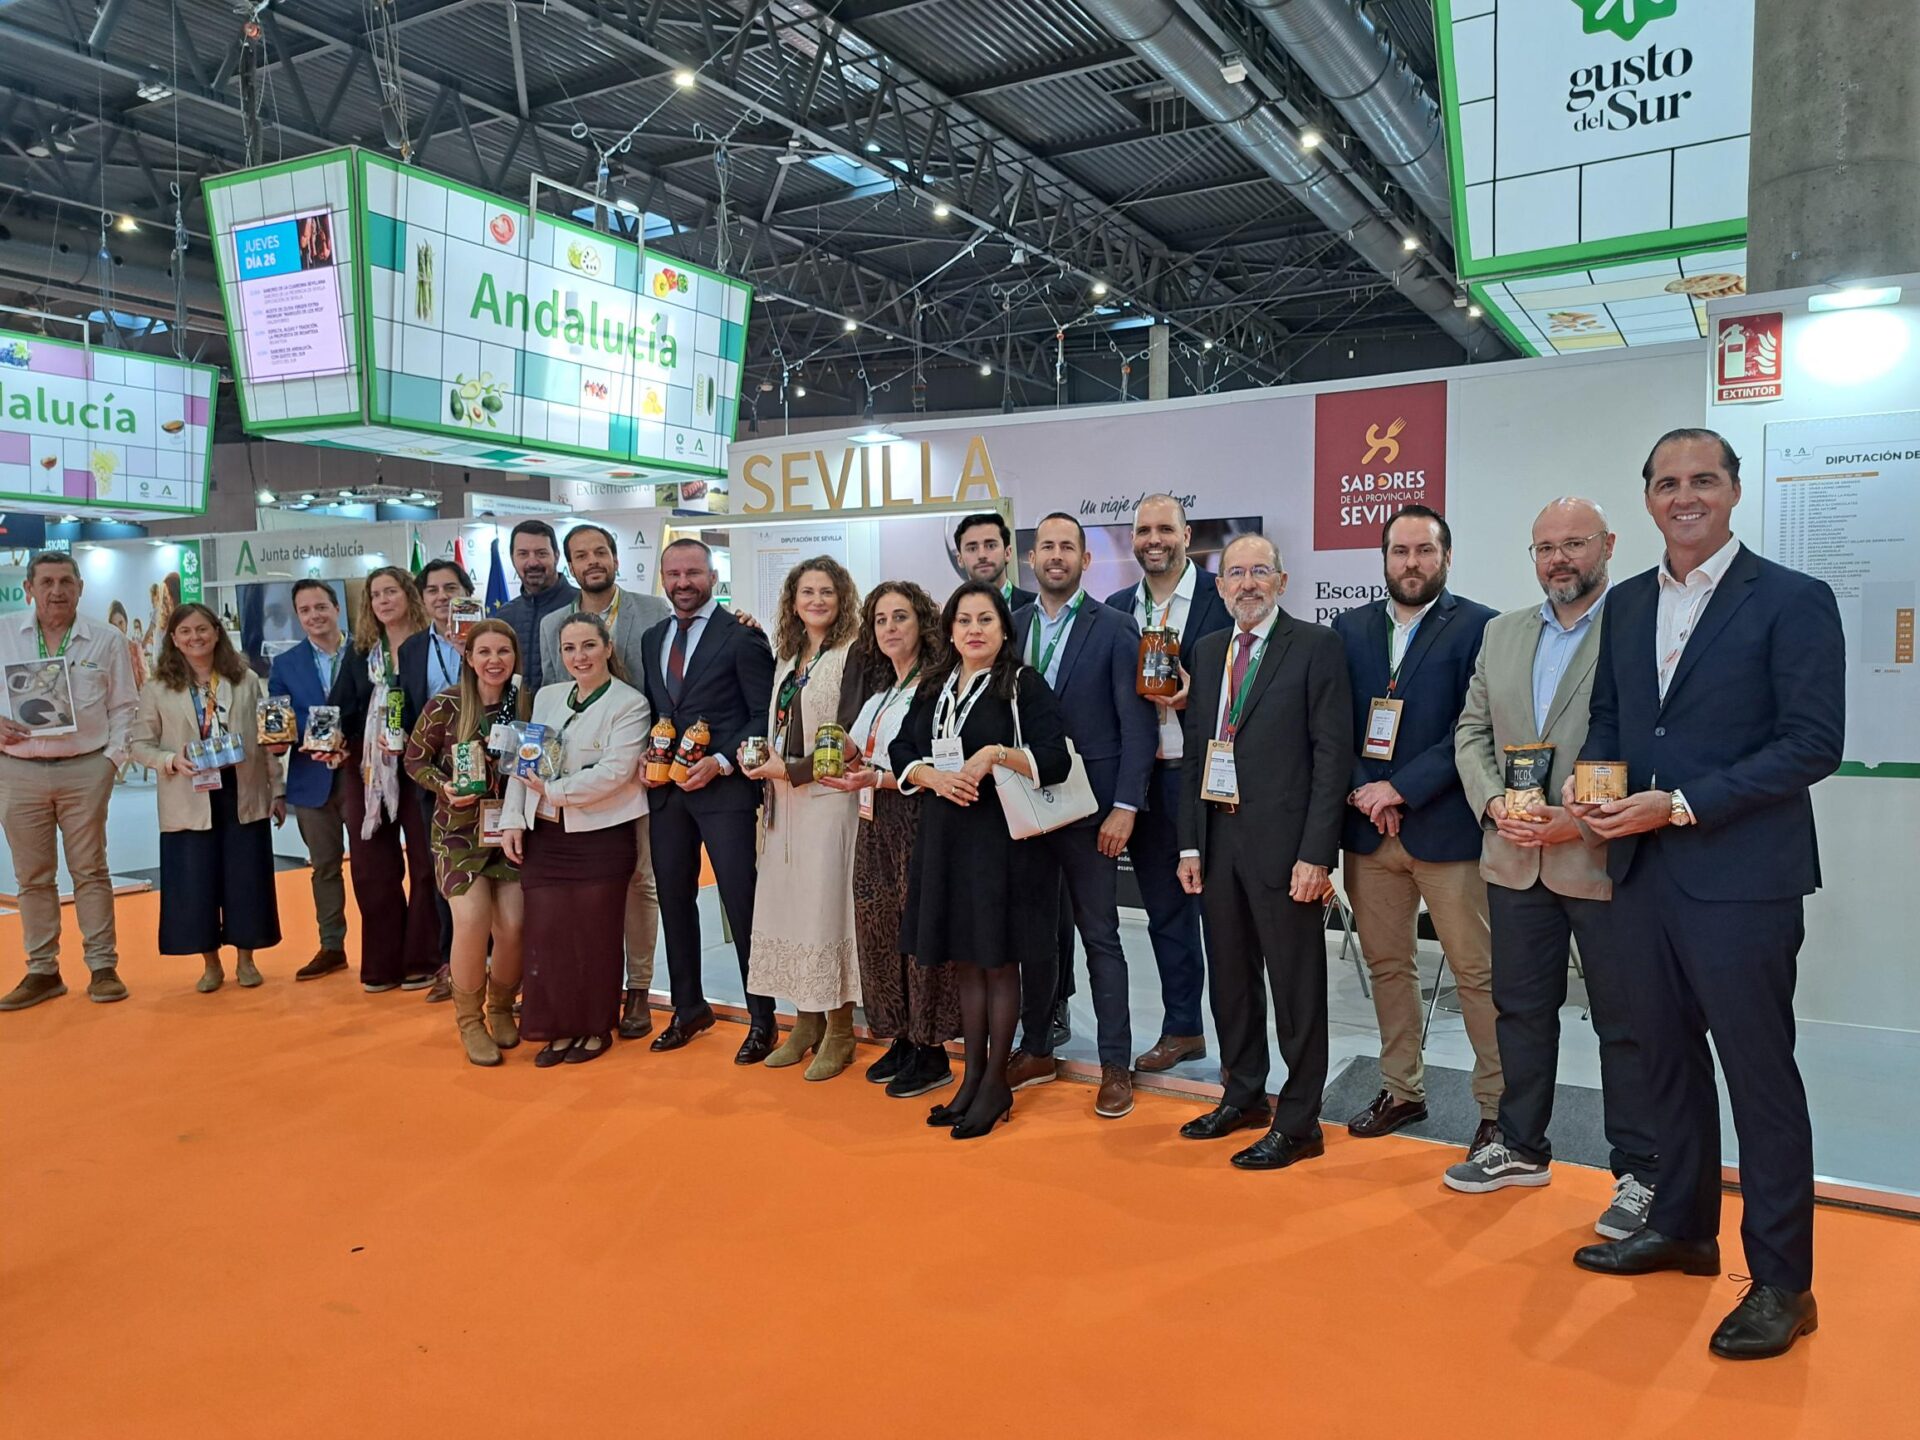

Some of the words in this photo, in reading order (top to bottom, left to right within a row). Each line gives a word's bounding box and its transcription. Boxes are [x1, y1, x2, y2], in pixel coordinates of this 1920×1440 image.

[1566, 44, 1693, 112] gusto
[1574, 110, 1603, 132] del
[1608, 89, 1692, 131] Sur
[244, 235, 279, 253] JUEVES
[246, 254, 262, 270] DÍA
[264, 253, 276, 266] 26
[470, 272, 677, 369] Andalucía
[1723, 386, 1776, 399] EXTINTOR
[0, 381, 136, 434] alucía
[1826, 451, 1901, 465] DIPUTACIÓN
[1905, 450, 1920, 460] DE
[742, 434, 1001, 513] SEVILLA
[1340, 470, 1425, 492] SABORES
[1340, 495, 1351, 504] DE
[1354, 494, 1363, 503] LA
[1366, 491, 1411, 502] PROVINCIA
[1414, 490, 1425, 499] DE
[260, 548, 290, 562] Junta
[293, 546, 305, 559] de
[308, 540, 364, 557] Andalucía
